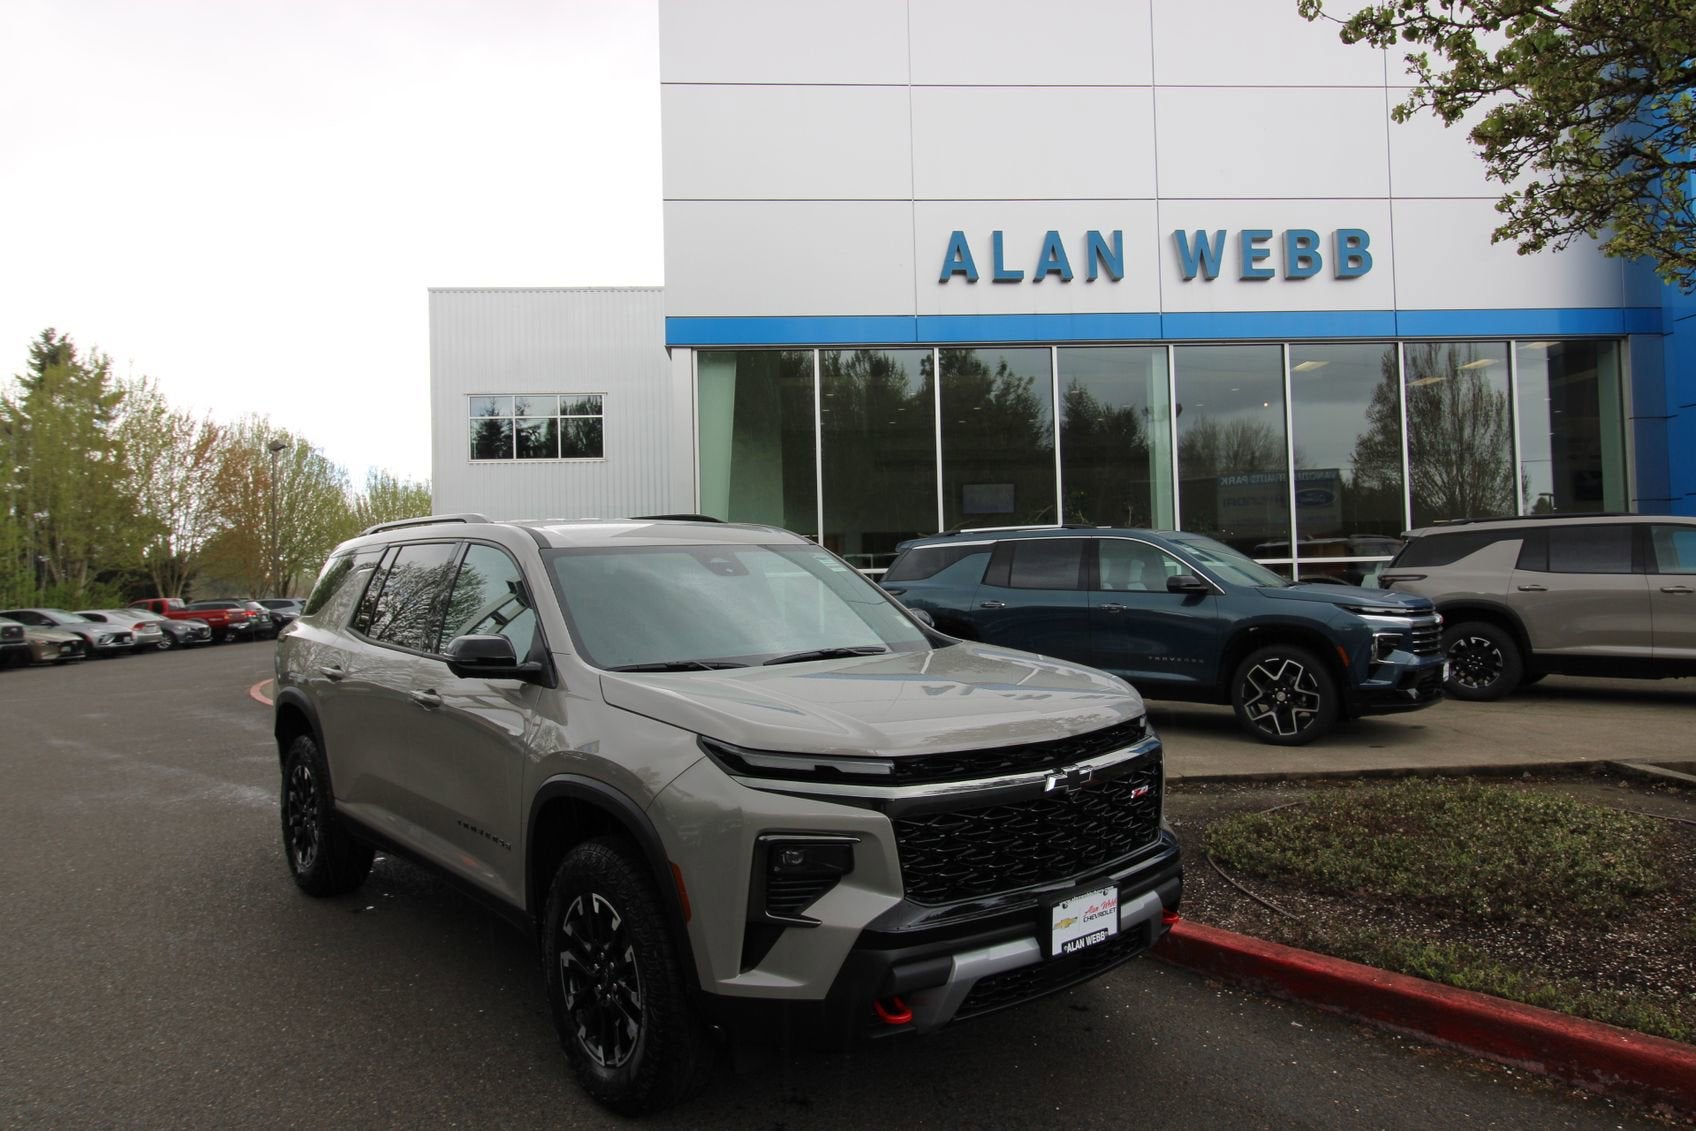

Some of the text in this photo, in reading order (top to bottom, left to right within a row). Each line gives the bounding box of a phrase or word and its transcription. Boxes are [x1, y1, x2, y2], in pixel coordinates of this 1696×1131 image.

[939, 228, 1373, 284] ALAN WEBB
[1083, 906, 1116, 923] CHEVROLET
[1066, 931, 1106, 953] ALAN WEBB
